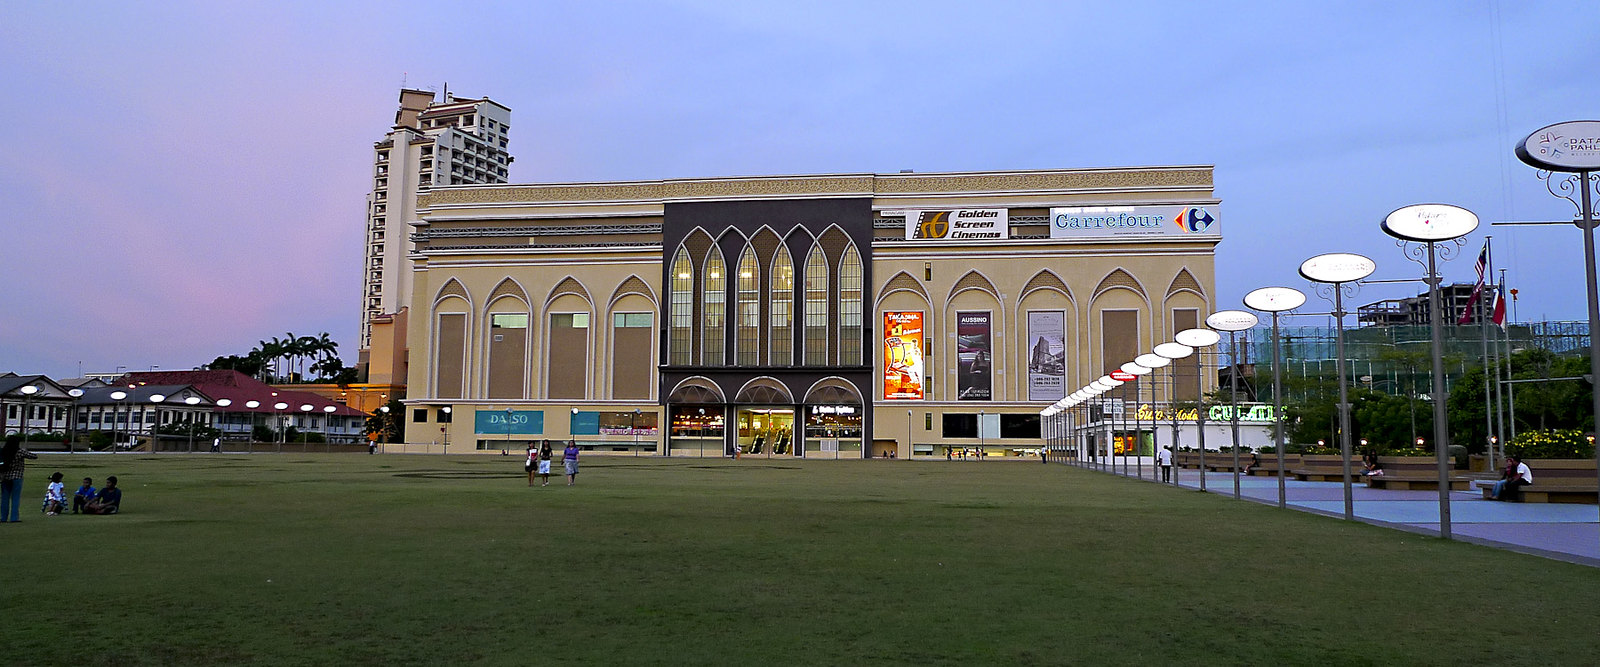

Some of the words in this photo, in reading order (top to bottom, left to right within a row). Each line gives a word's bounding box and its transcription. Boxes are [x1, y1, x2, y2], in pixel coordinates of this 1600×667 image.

[957, 210, 998, 218] Golden
[953, 220, 995, 229] Screen
[1055, 212, 1164, 229] Carrefour
[951, 230, 1001, 239] Cinemas
[1134, 403, 1164, 421] Euo
[490, 414, 528, 424] DAISO
